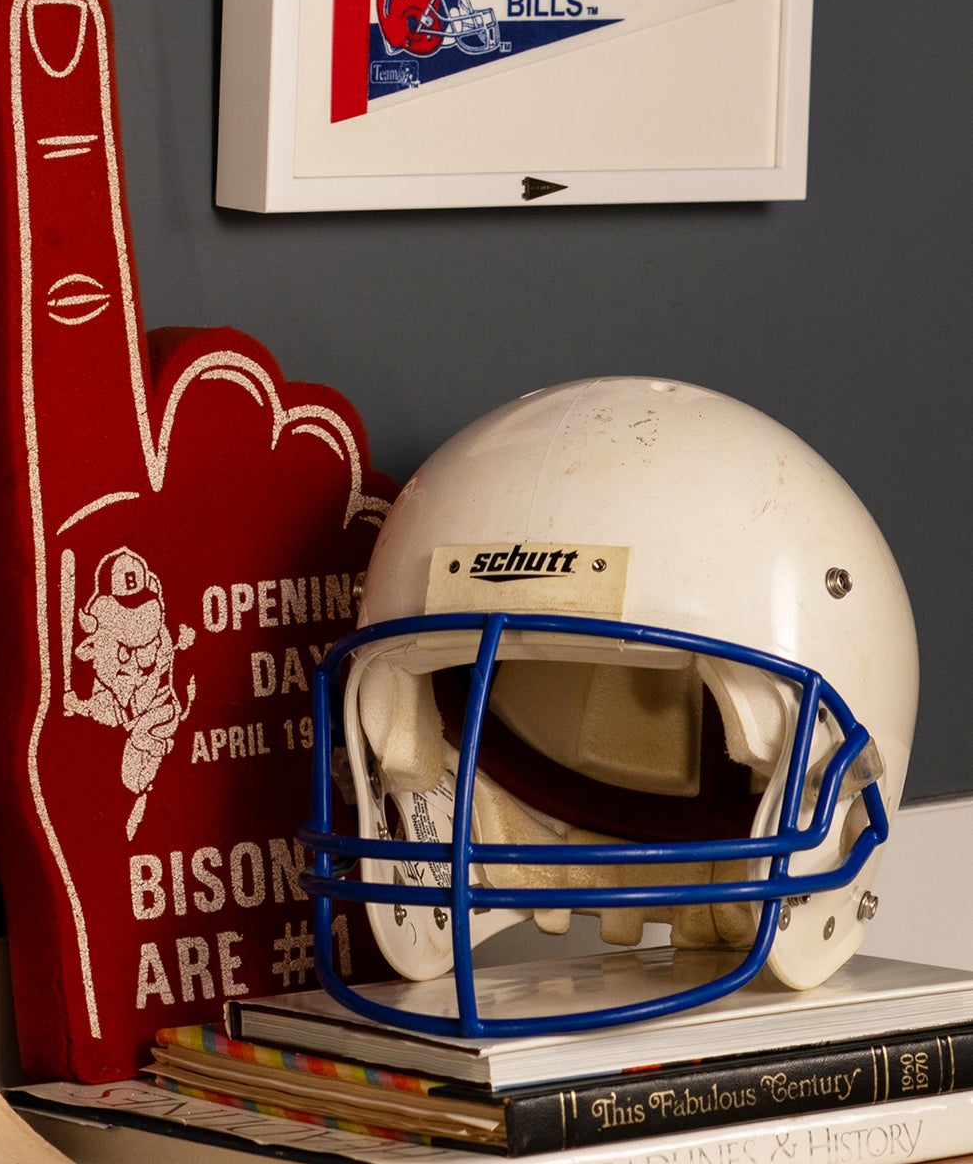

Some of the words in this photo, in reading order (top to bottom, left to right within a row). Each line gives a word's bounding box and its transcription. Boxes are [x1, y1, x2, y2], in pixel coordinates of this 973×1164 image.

[373, 64, 398, 81] Team
[470, 545, 578, 573] schutt
[191, 722, 272, 765] APRIL
[283, 715, 315, 750] 19
[129, 837, 311, 920] BISON
[136, 931, 250, 1010] ARE
[271, 914, 353, 987] #1
[901, 1053, 914, 1092] 1960
[915, 1051, 929, 1090] 1970
[592, 1092, 645, 1130] This
[649, 1084, 756, 1117] Fabulous
[761, 1068, 862, 1103] Century
[808, 1120, 924, 1158] HISTORY
